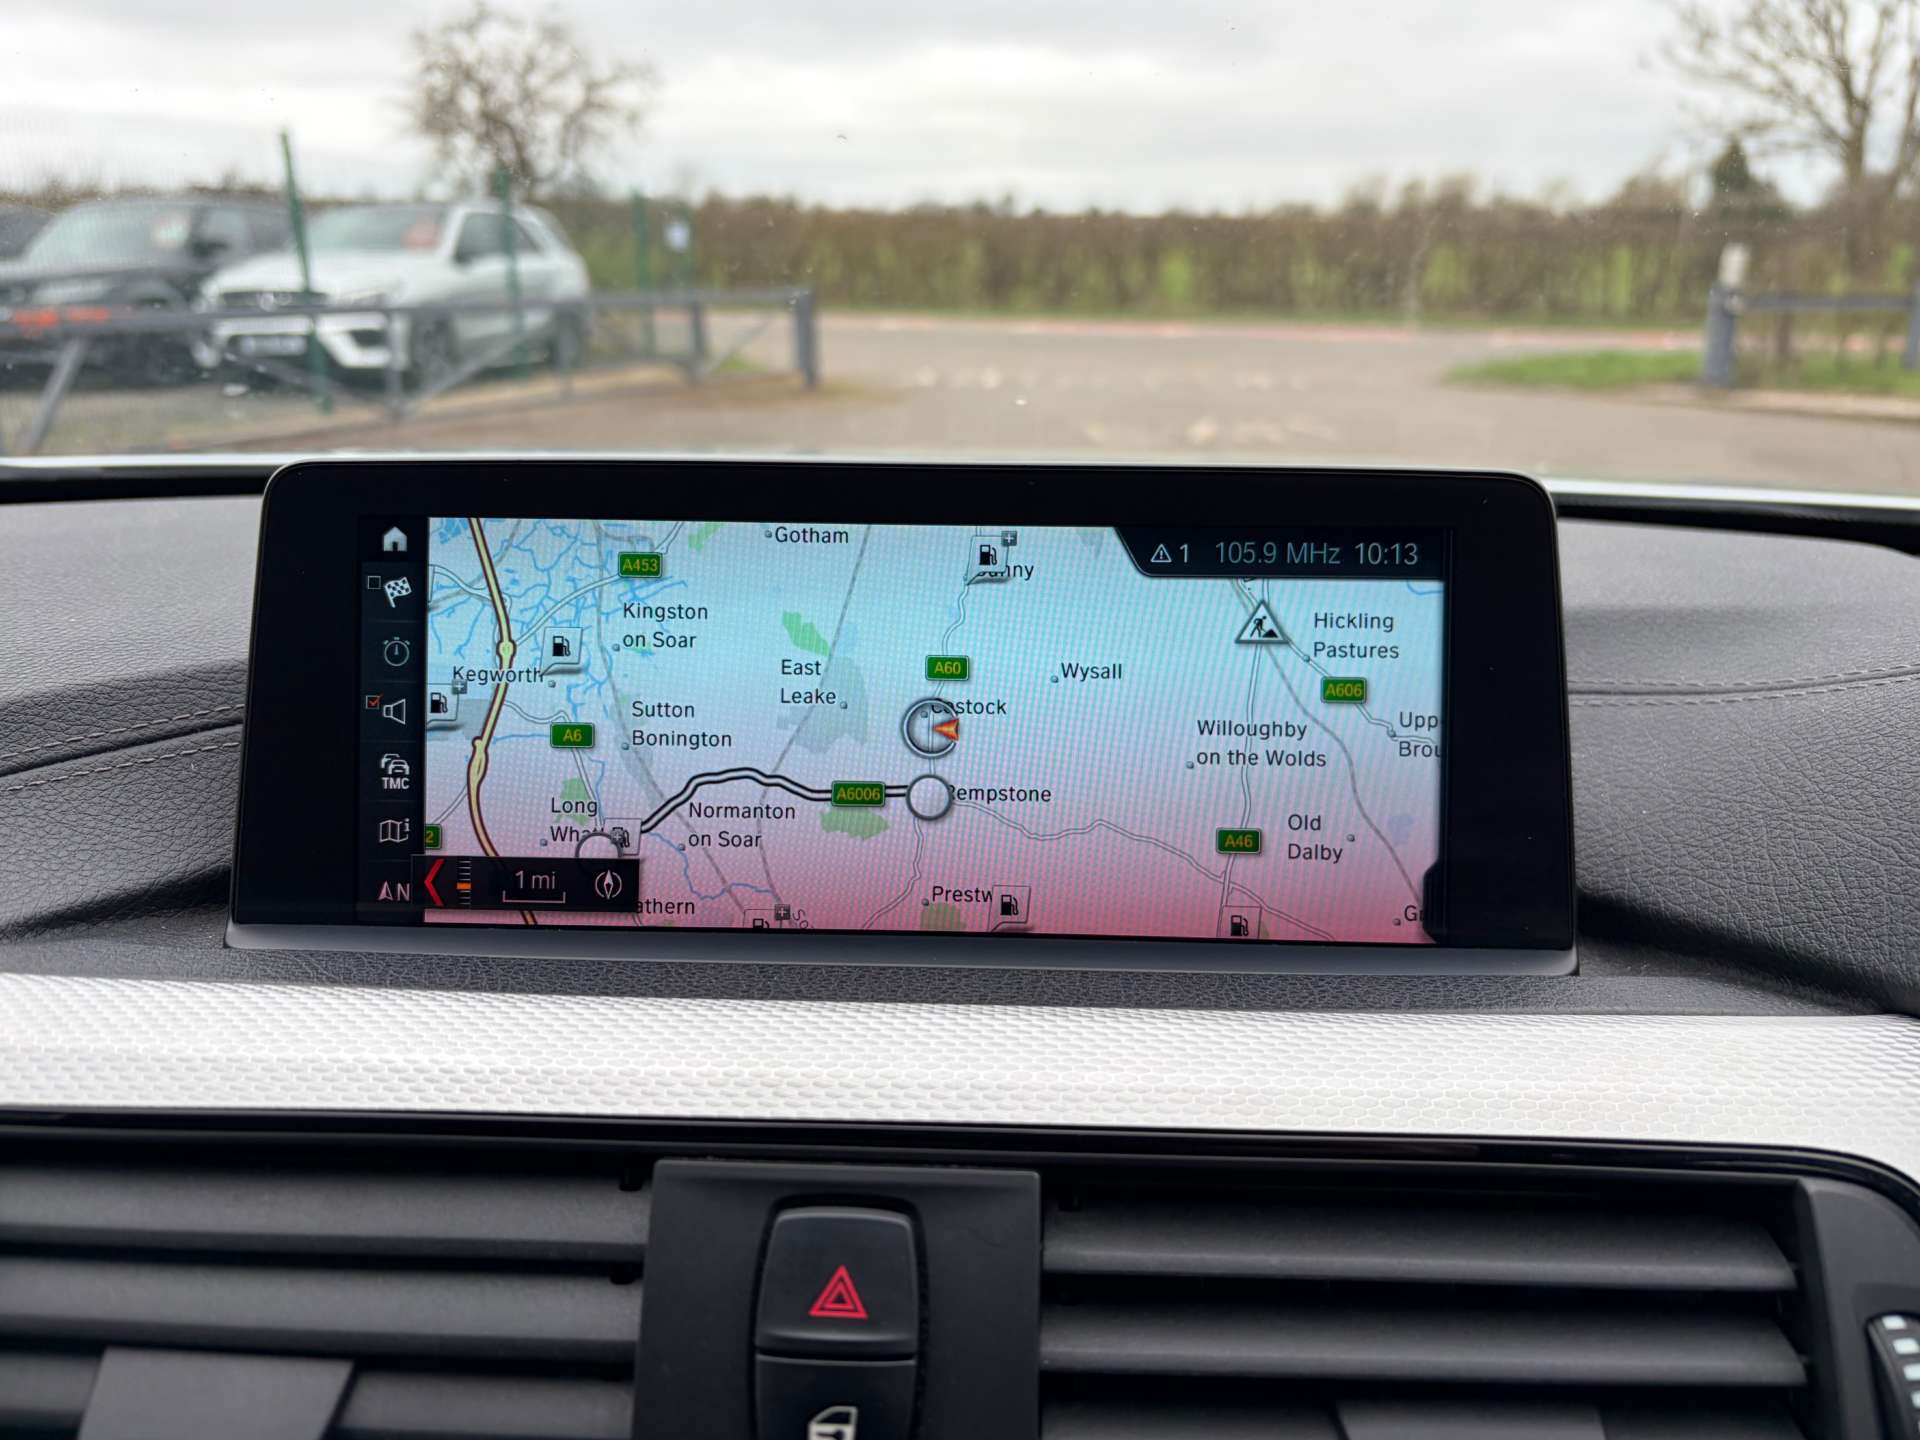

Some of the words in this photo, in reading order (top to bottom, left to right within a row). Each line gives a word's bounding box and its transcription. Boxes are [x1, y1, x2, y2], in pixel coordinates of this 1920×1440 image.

[774, 526, 849, 544] Gotham
[1179, 544, 1190, 563] 1
[1215, 541, 1277, 564] 105.9
[1287, 541, 1341, 564] MHz
[1354, 542, 1419, 565] 10:13
[622, 557, 658, 572] A453
[622, 602, 708, 622] Kingston
[1314, 612, 1394, 632] Hickling
[622, 634, 648, 648] on
[652, 632, 697, 648] Soar
[1313, 642, 1400, 660] Pastures
[452, 665, 544, 685] Kegworth
[780, 658, 822, 676] East
[934, 661, 961, 676] A60
[1061, 662, 1122, 684] Wysall
[780, 688, 837, 706] Leake
[1325, 682, 1363, 698] A606
[632, 701, 695, 718] Sutton
[1197, 719, 1308, 740] Willoughby
[1399, 711, 1439, 731] Upp
[562, 728, 583, 743] A6
[632, 730, 732, 752] Bonington
[1196, 752, 1219, 765] on
[1228, 749, 1259, 766] the
[1266, 750, 1327, 768] Wolds
[381, 777, 410, 790] TMC
[836, 786, 881, 802] A6006
[551, 797, 598, 817] Long
[688, 802, 796, 821] Normanton
[1287, 814, 1322, 831] Old
[688, 833, 712, 848] on
[718, 831, 762, 849] Soar
[1224, 834, 1254, 849] A46
[1287, 844, 1343, 864] Dalby
[515, 870, 524, 889] 1
[531, 870, 556, 889] mi
[397, 883, 411, 901] N
